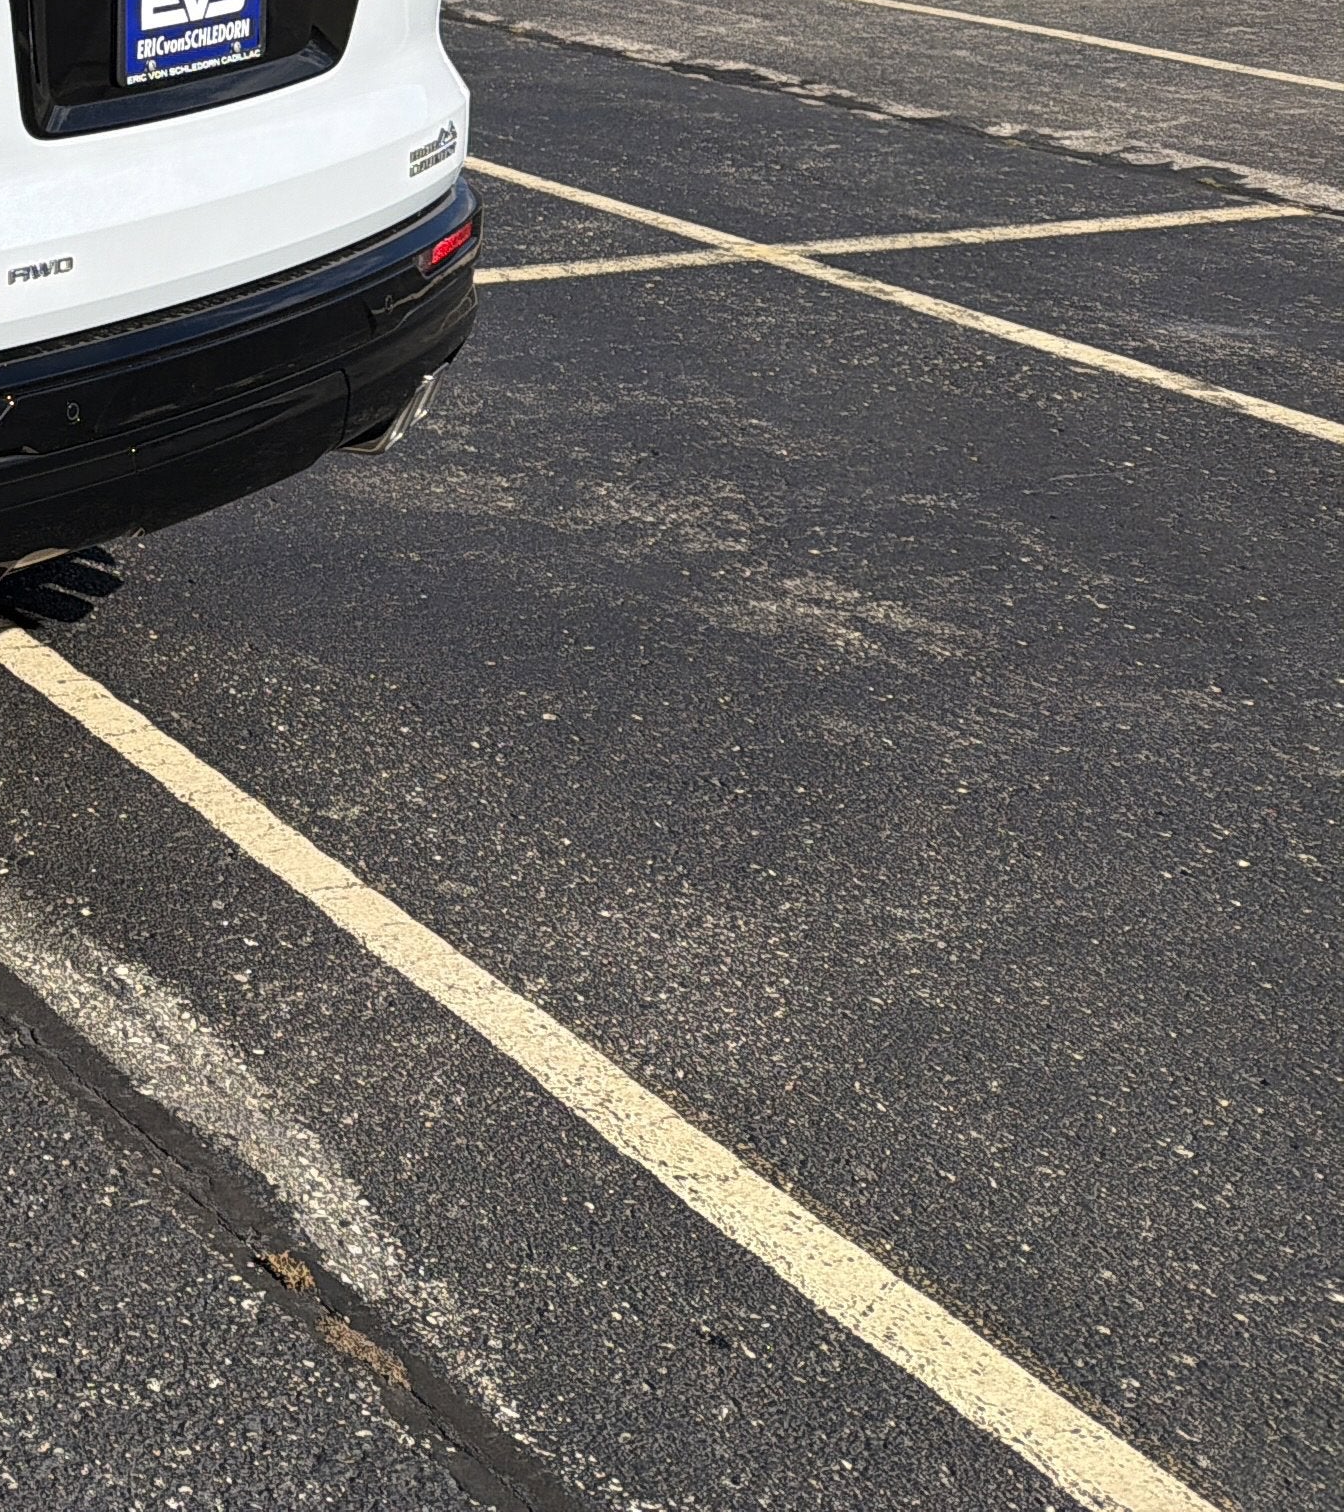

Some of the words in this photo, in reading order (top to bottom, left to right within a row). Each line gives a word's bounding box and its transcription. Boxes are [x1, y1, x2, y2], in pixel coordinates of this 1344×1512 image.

[127, 74, 147, 85] ERIC
[148, 69, 168, 81] VON
[169, 59, 221, 76] SCHLEDORN
[221, 49, 261, 64] CADILLAC
[7, 256, 74, 285] AWD
